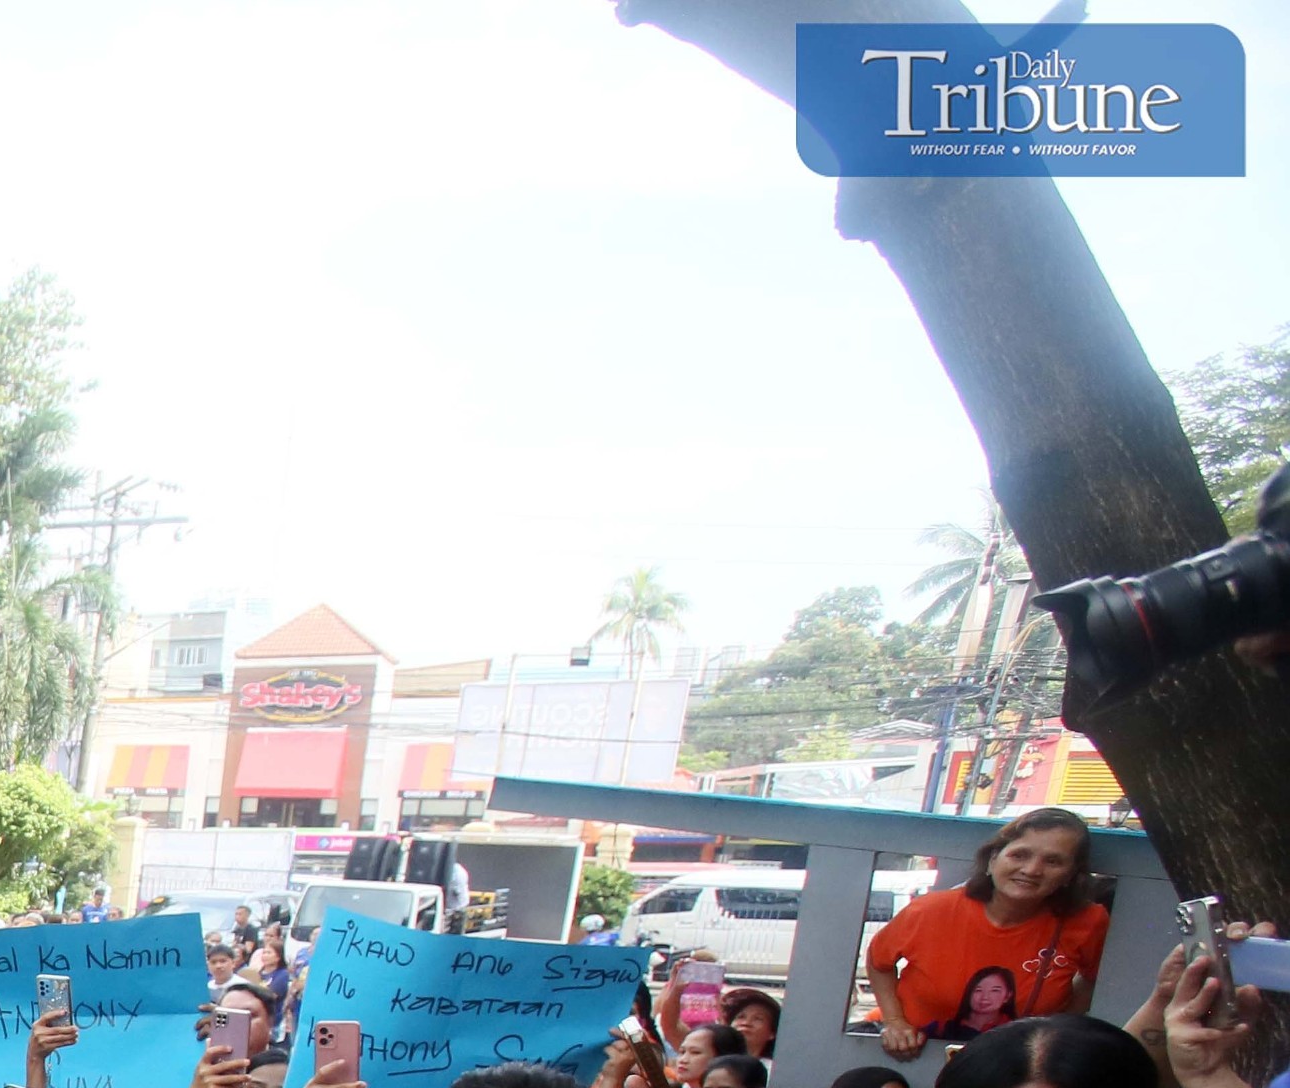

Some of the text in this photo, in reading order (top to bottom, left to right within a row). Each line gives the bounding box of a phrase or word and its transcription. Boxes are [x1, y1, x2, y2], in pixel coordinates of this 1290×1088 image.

[240, 681, 362, 710] Shakey's
[39, 946, 69, 972] Ka
[86, 940, 181, 970] Namin
